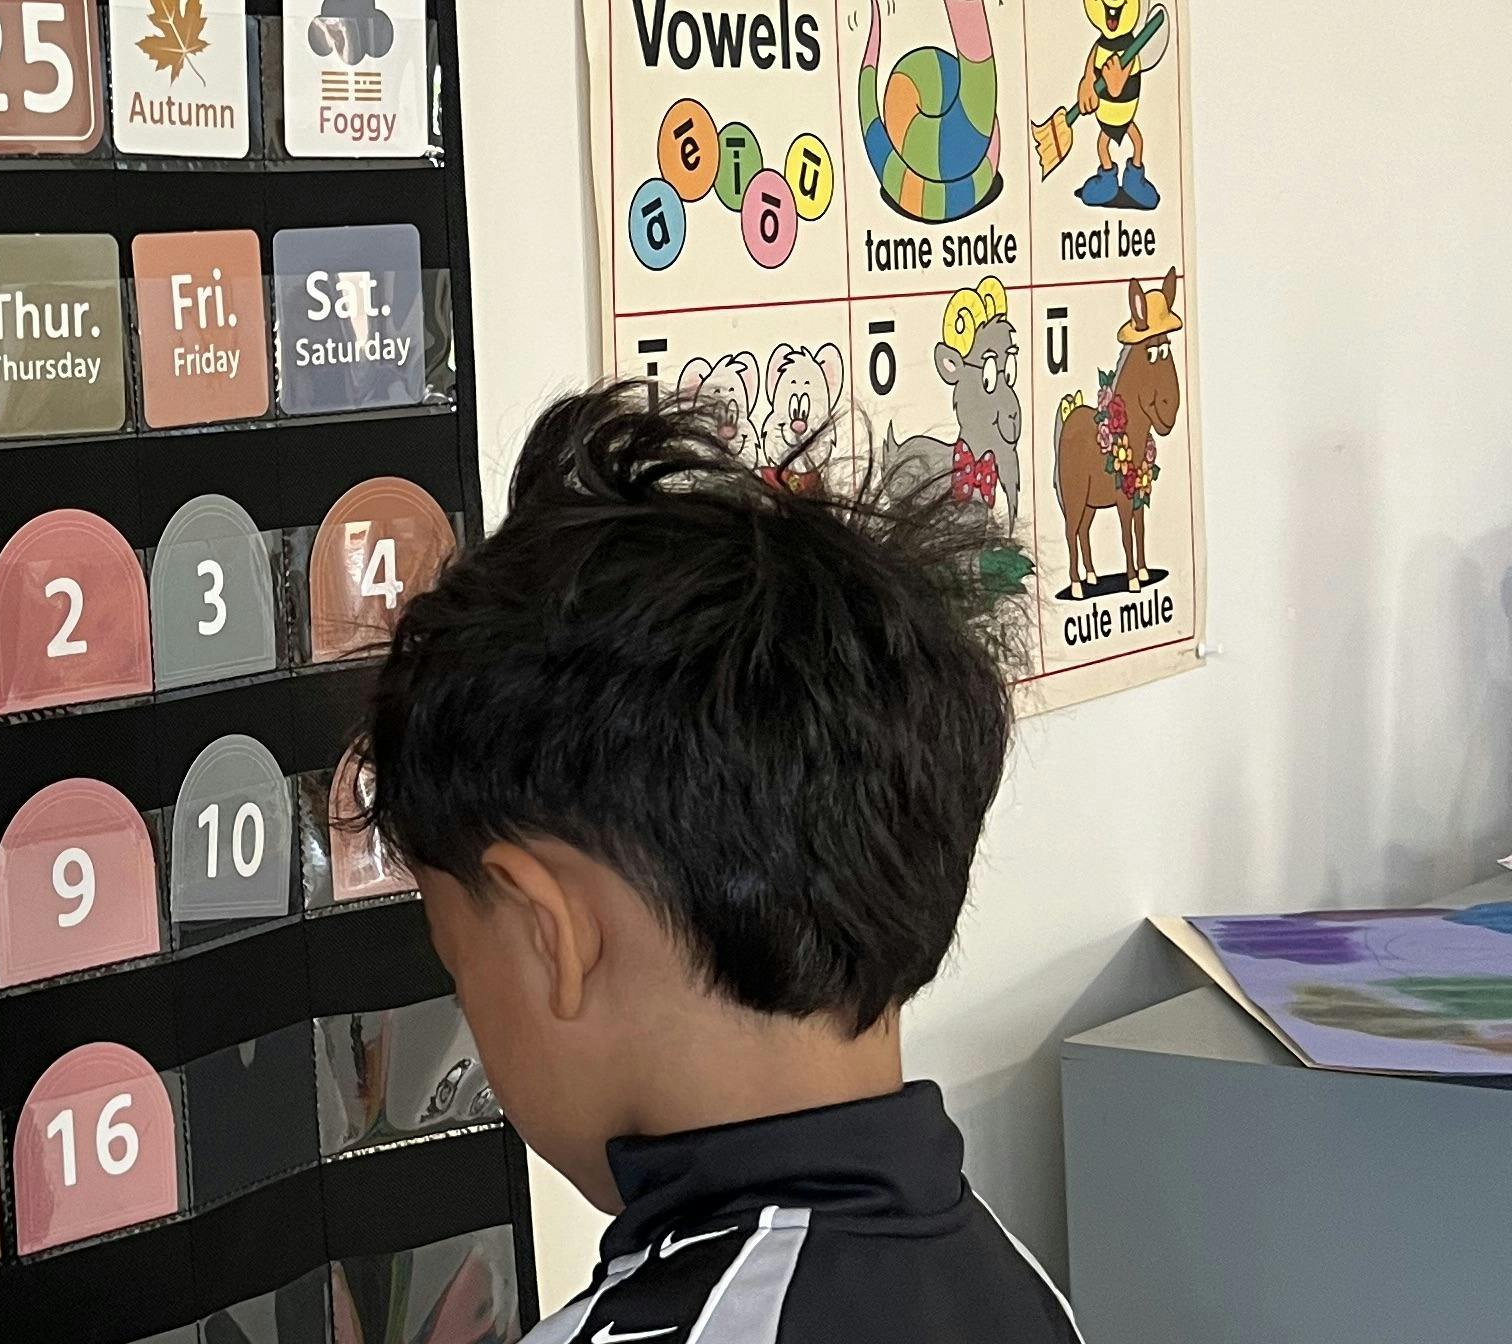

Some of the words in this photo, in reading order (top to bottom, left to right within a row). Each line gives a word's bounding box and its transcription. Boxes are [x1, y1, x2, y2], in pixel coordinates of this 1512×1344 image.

[128, 91, 235, 129] Autumn
[319, 105, 397, 142] Foggy
[864, 229, 933, 272] tame
[942, 224, 1018, 268] snake
[1061, 220, 1111, 261] neat
[1118, 219, 1156, 258] bee
[171, 267, 238, 331] Fri.
[306, 270, 391, 321] Sat.
[173, 343, 241, 379] Friday
[295, 331, 411, 367] Saturday
[197, 559, 227, 636] 3
[360, 538, 404, 610] 4
[44, 577, 88, 658] 2
[1063, 601, 1113, 647] cute
[1119, 588, 1174, 634] mule
[198, 802, 265, 878] 10
[52, 847, 96, 928] 9
[47, 1093, 139, 1187] 16
